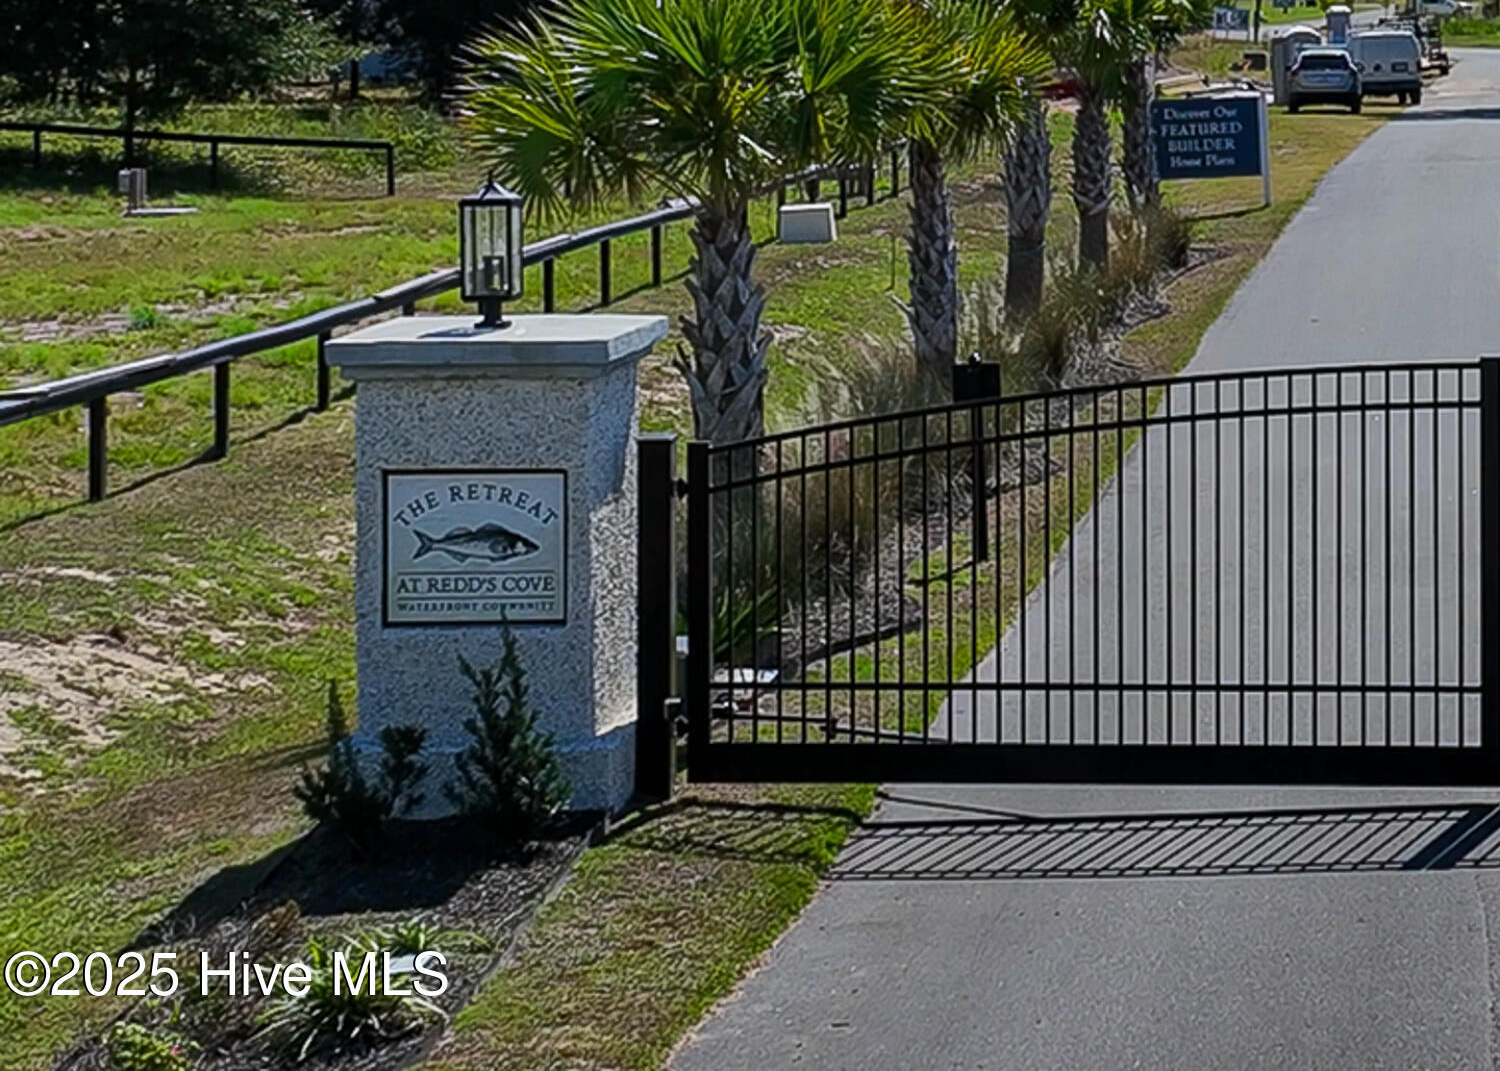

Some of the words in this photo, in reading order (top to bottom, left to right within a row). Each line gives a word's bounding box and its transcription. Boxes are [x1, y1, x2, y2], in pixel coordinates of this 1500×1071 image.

[1160, 121, 1243, 137] FEATURED
[1168, 138, 1236, 152] BUILDER
[394, 490, 441, 526] THE
[448, 483, 558, 526] RETREAT
[397, 578, 422, 593] AT
[427, 577, 497, 594] REDD'S
[502, 576, 555, 593] COVE
[398, 602, 479, 611] WATERFRONT
